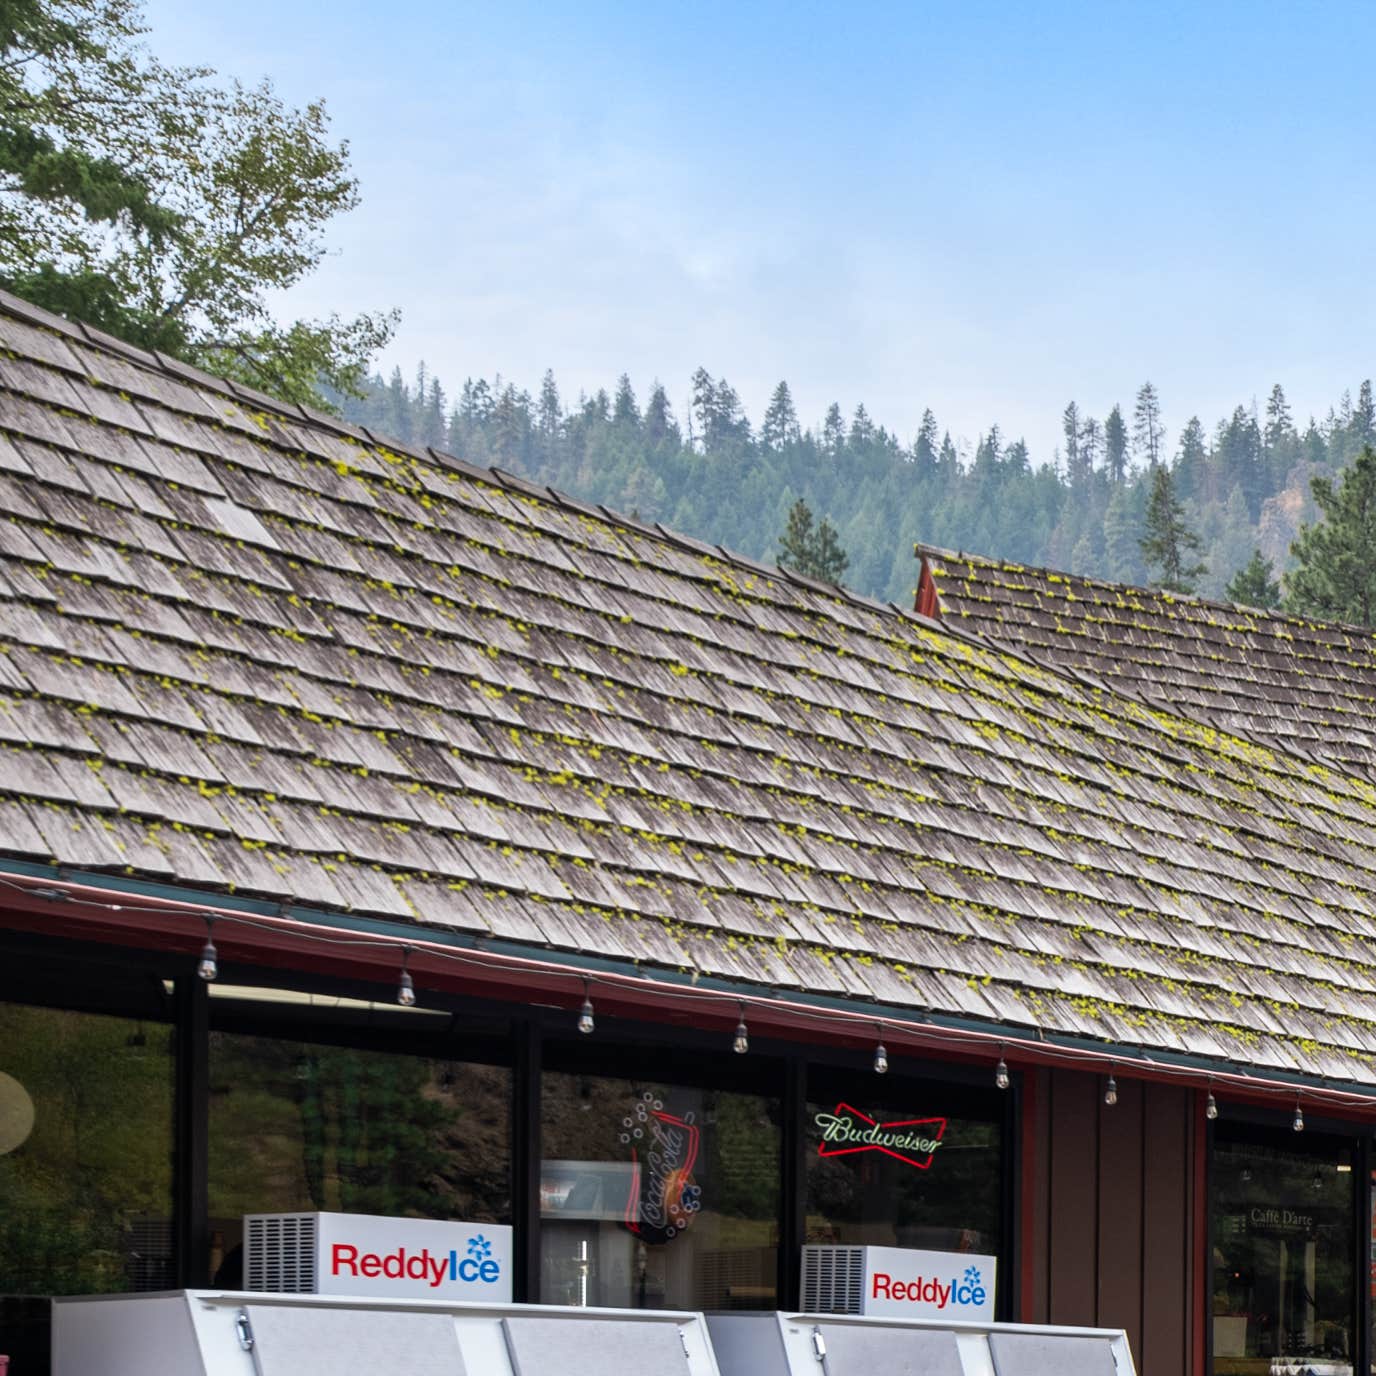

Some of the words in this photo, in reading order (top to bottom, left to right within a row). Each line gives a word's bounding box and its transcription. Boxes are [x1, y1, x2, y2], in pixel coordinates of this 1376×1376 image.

[815, 1112, 942, 1154] Budweiser
[331, 1243, 500, 1288] ReddyIce
[872, 1272, 986, 1310] ReddyIce
